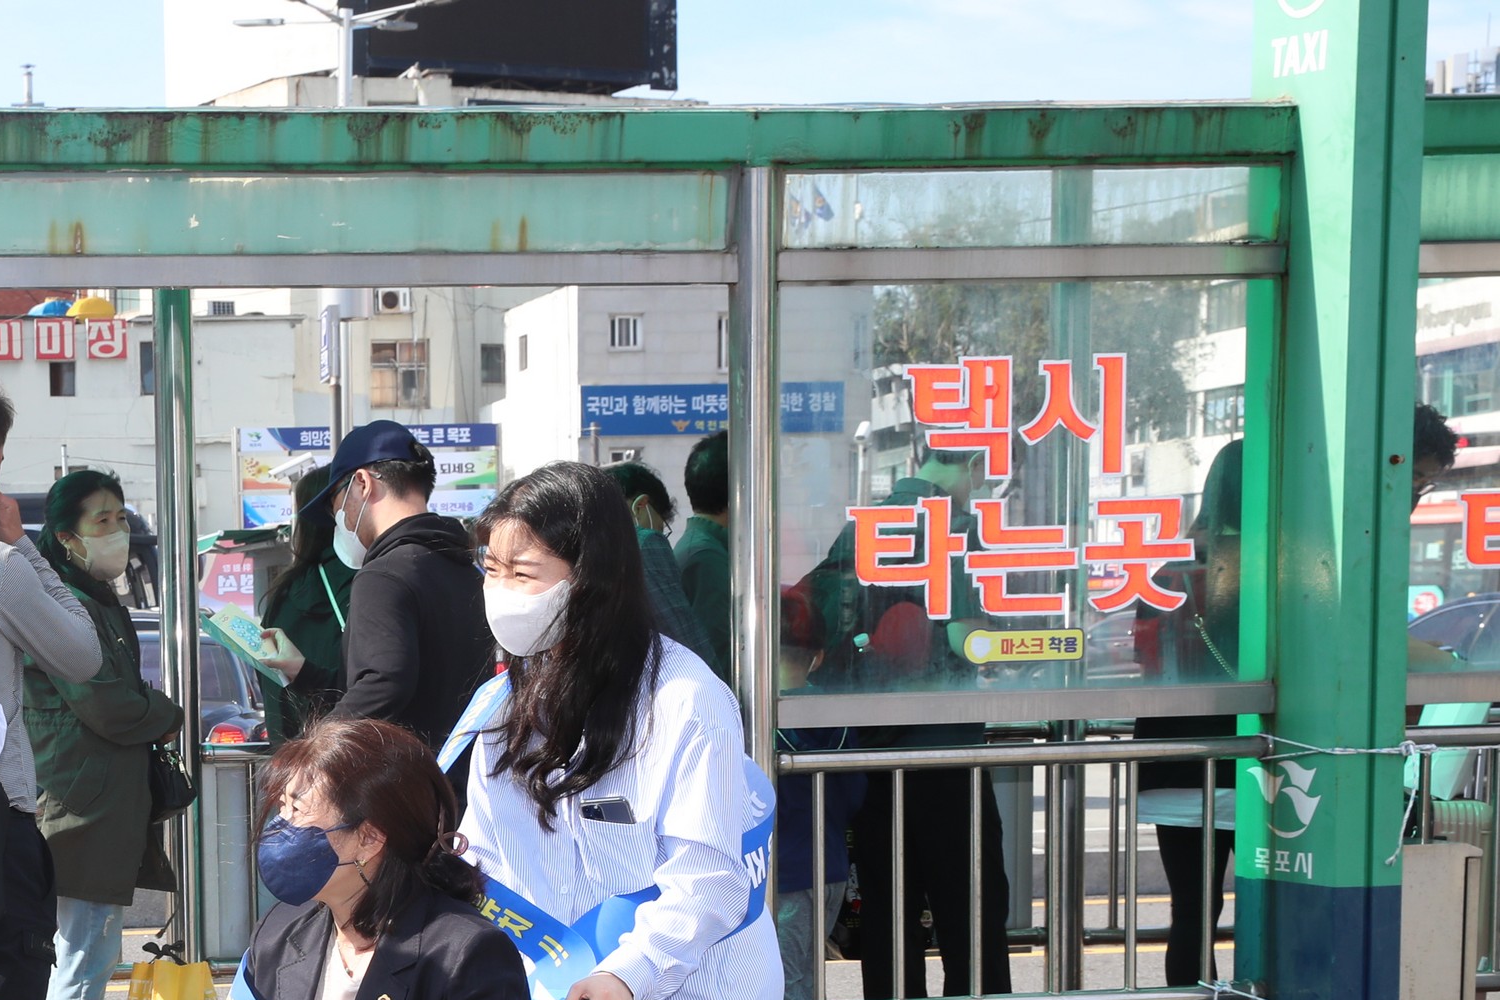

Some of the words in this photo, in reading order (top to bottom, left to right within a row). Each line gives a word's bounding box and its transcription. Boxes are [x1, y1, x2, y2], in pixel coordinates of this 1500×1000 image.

[1271, 28, 1329, 79] TAXI
[586, 396, 628, 415] 국민과
[632, 394, 687, 415] 함께하는
[808, 391, 837, 412] 경찰
[902, 352, 1127, 480] 택시
[432, 428, 445, 444] 큰
[447, 427, 472, 443] 목포
[439, 462, 476, 475] 되세요
[1001, 637, 1045, 656] 마스크
[1048, 636, 1079, 655] 착용
[1254, 847, 1313, 880] 목포시
